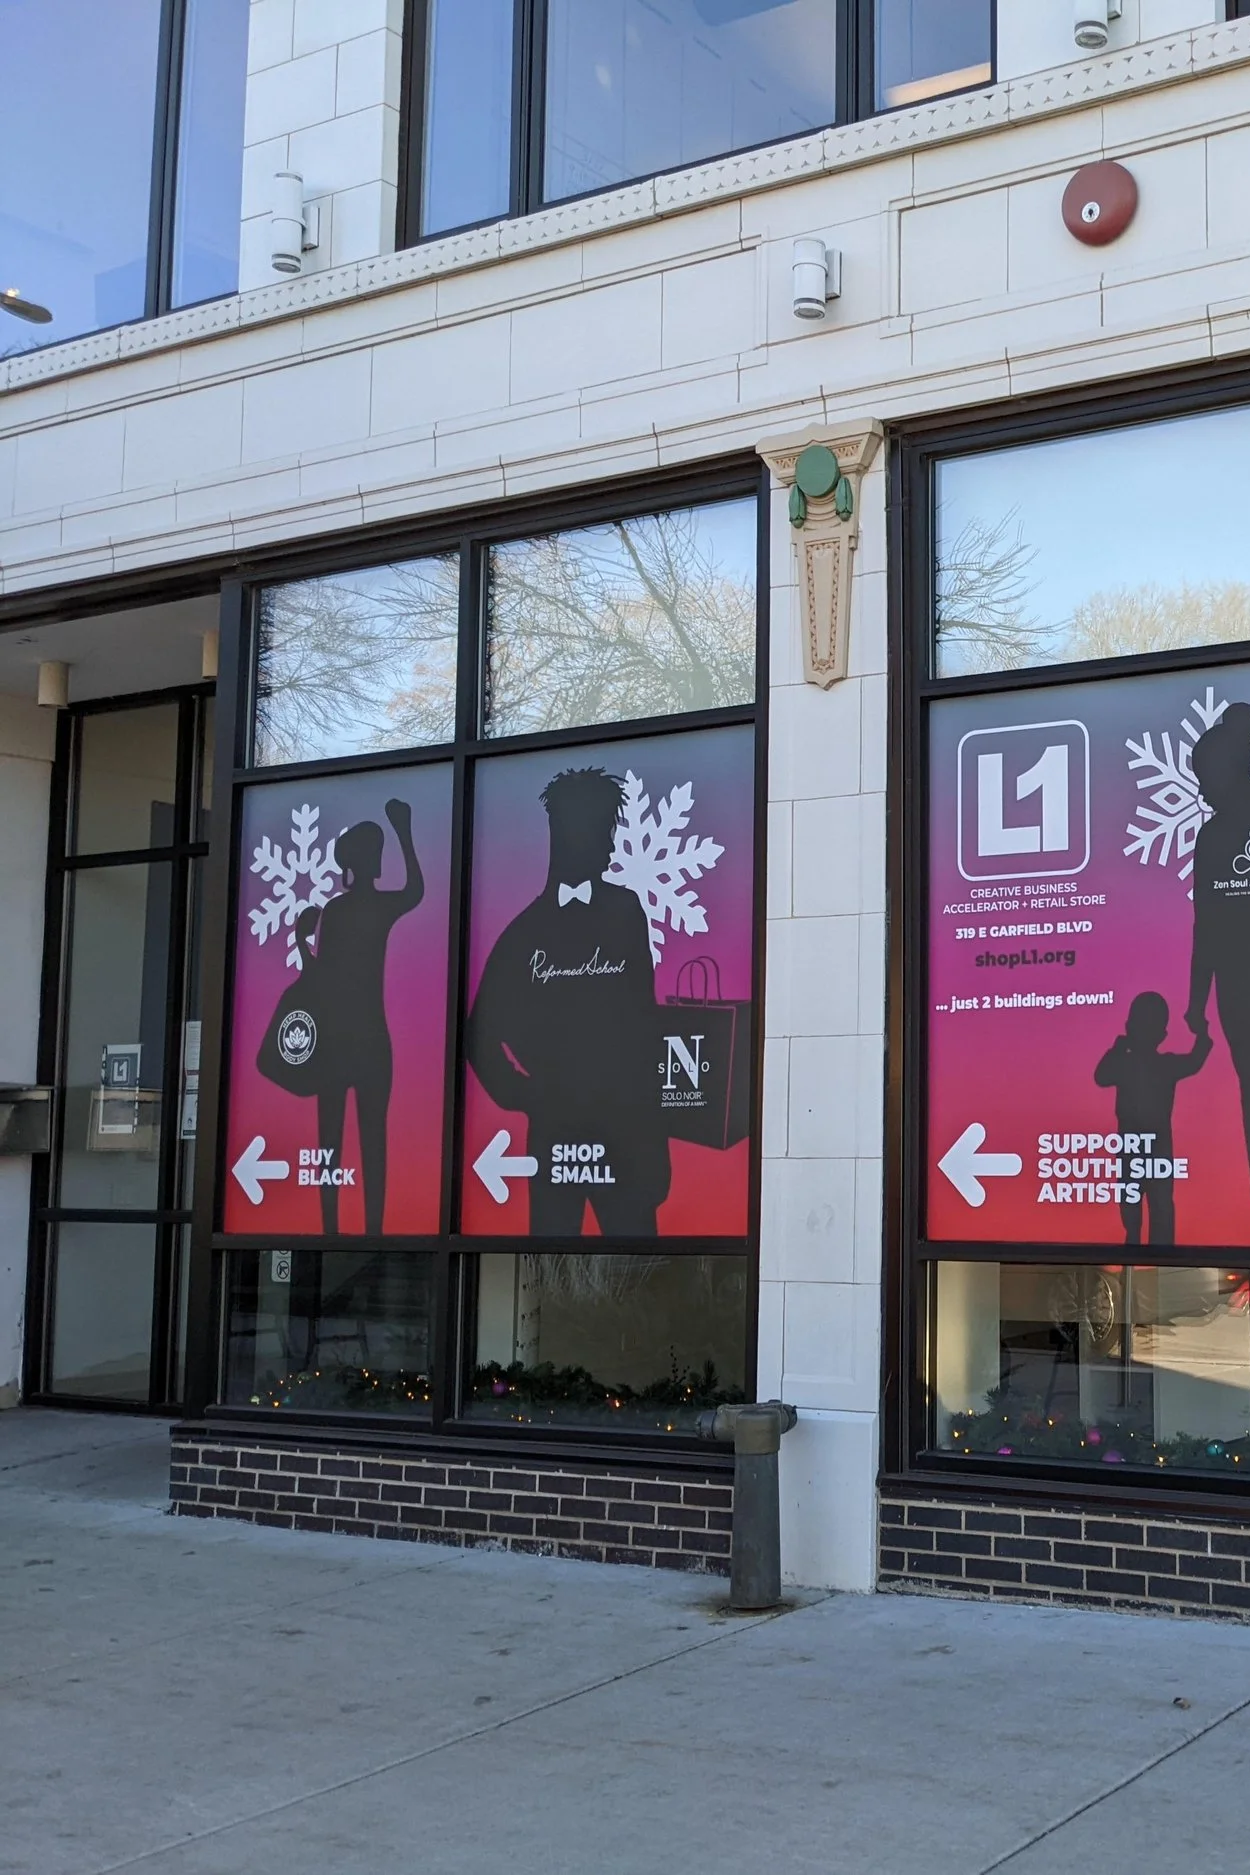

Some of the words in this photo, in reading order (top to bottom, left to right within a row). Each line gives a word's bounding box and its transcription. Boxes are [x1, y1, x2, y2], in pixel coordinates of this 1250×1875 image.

[977, 744, 1070, 856] L1
[970, 885, 1020, 898] CREATIVE
[1024, 882, 1076, 895] BUSINESS
[1230, 878, 1248, 888] Soul
[943, 900, 1019, 913] ACCELERATOR
[1030, 896, 1067, 908] RETAIL
[1069, 894, 1105, 906] STORE
[955, 927, 975, 939] 319
[978, 926, 986, 937] E
[989, 923, 1053, 937] GARFIELD
[1056, 920, 1092, 933] BLVD
[530, 948, 585, 984] Reformed
[585, 946, 626, 976] School
[975, 949, 1075, 969] shopL1.org
[950, 995, 978, 1012] just
[982, 995, 990, 1008] 2
[994, 992, 1062, 1008] buildings
[1066, 990, 1113, 1004] down!
[662, 1092, 682, 1100] SOLO
[683, 1092, 702, 1100] NOIR
[551, 1143, 604, 1162] SHOP
[1038, 1133, 1155, 1154] SUPPORT
[299, 1148, 333, 1165] BUY
[298, 1168, 354, 1185] BLACK
[550, 1165, 615, 1183] SMALL
[1038, 1157, 1121, 1178] SOUTH
[1129, 1157, 1188, 1178] SIDE
[1037, 1182, 1140, 1203] ARTISTS
